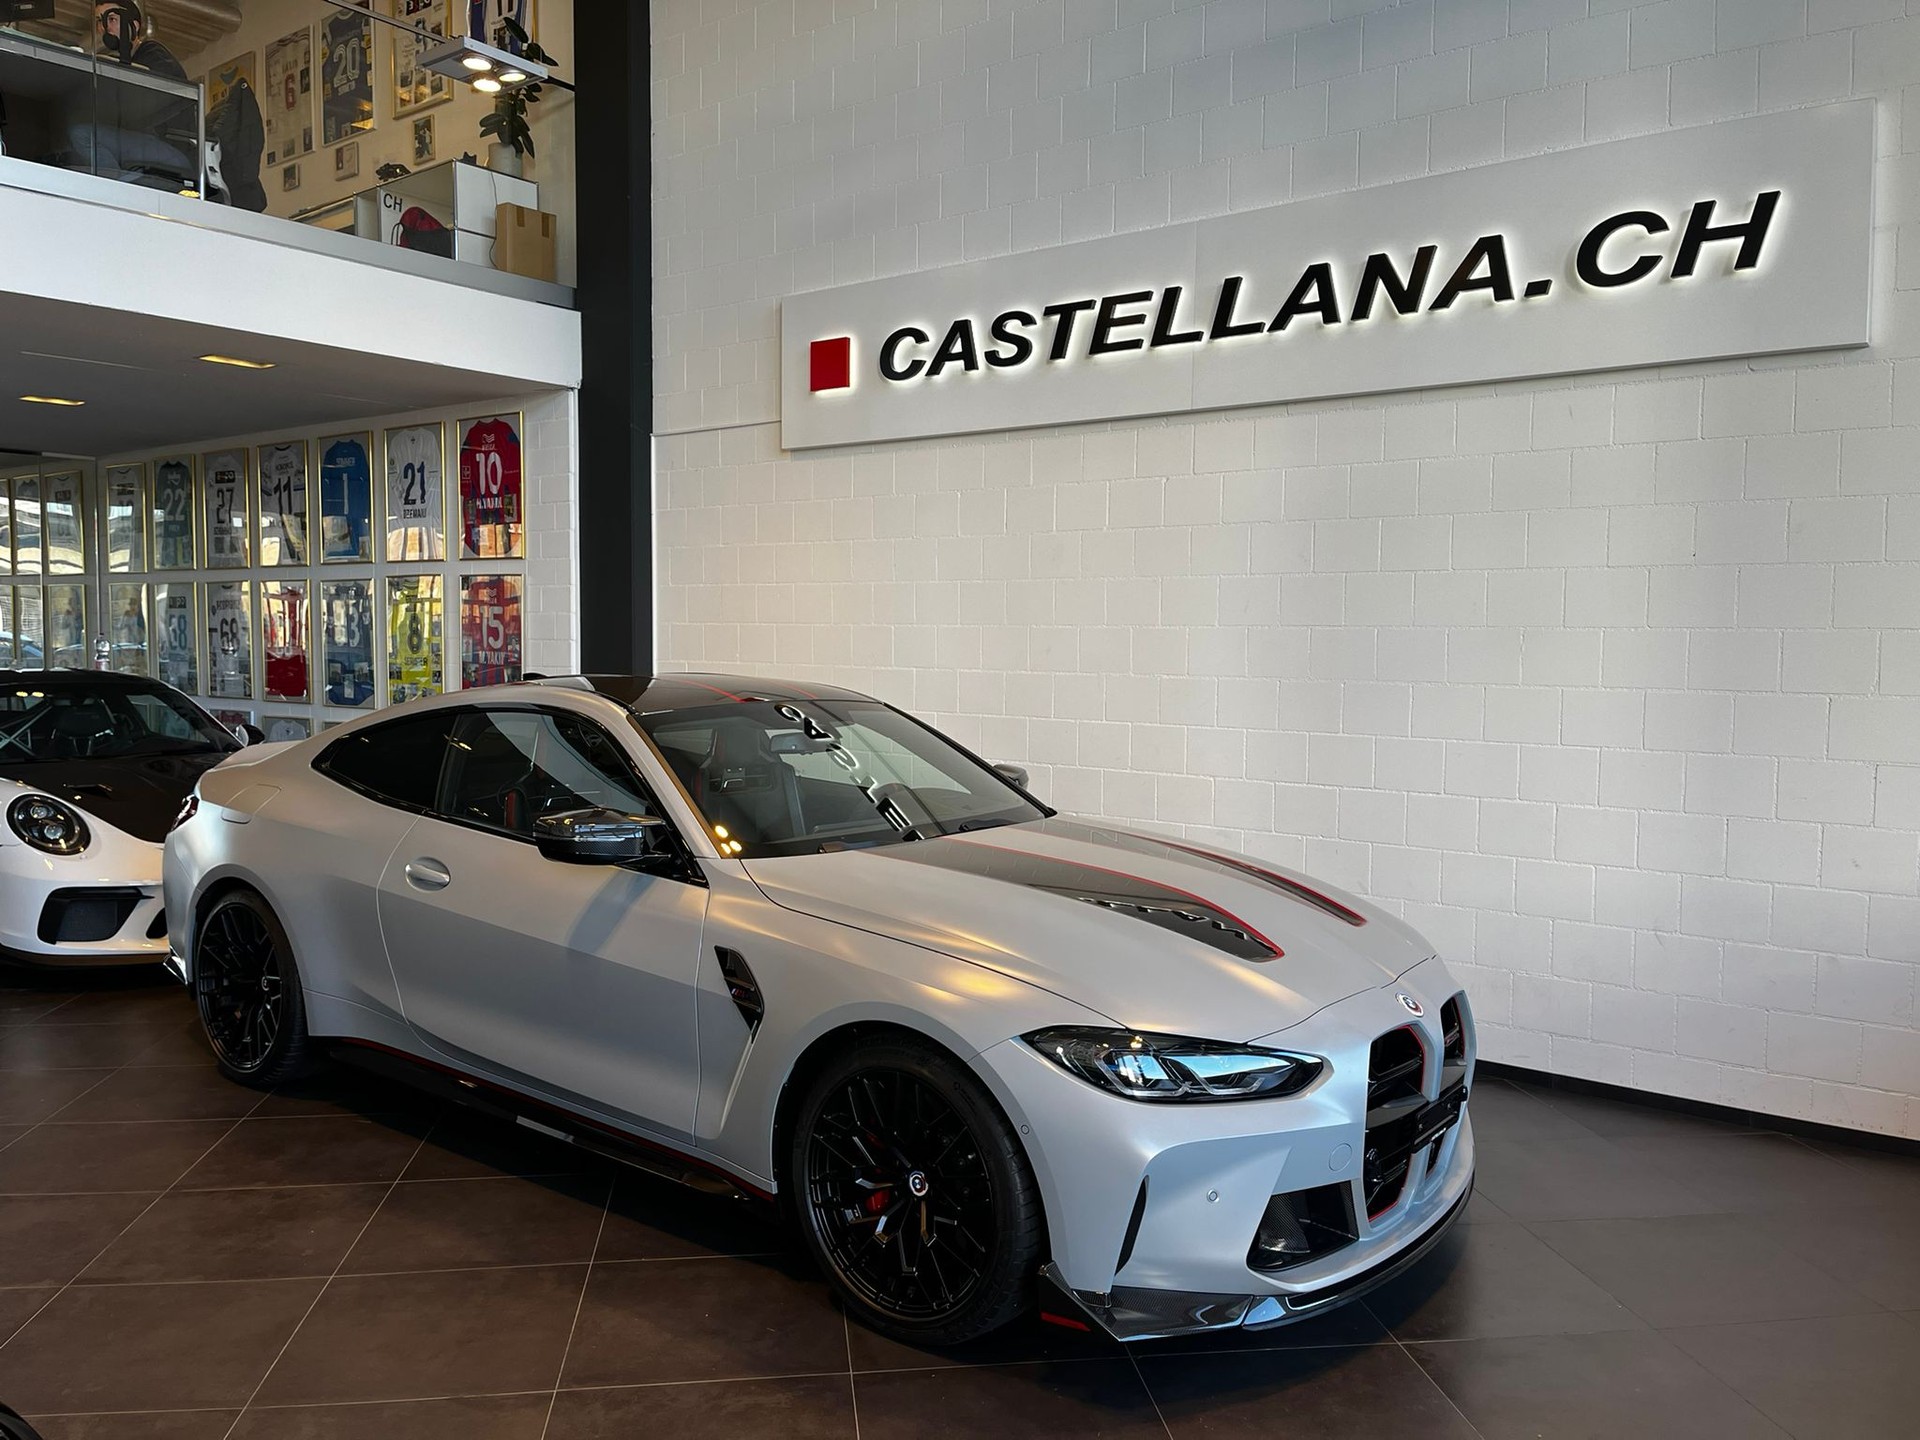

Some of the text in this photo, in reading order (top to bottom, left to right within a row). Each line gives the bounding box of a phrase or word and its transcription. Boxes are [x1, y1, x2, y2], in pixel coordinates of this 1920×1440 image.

[333, 38, 360, 88] 20
[383, 193, 403, 213] CH
[879, 190, 1782, 382] CASTELLANA.CH
[342, 472, 349, 515] 1
[403, 461, 426, 505] 21
[476, 451, 503, 495] 10
[164, 487, 186, 521] 22
[216, 487, 235, 524] 27
[273, 475, 292, 516] 11
[479, 605, 505, 650] 15
